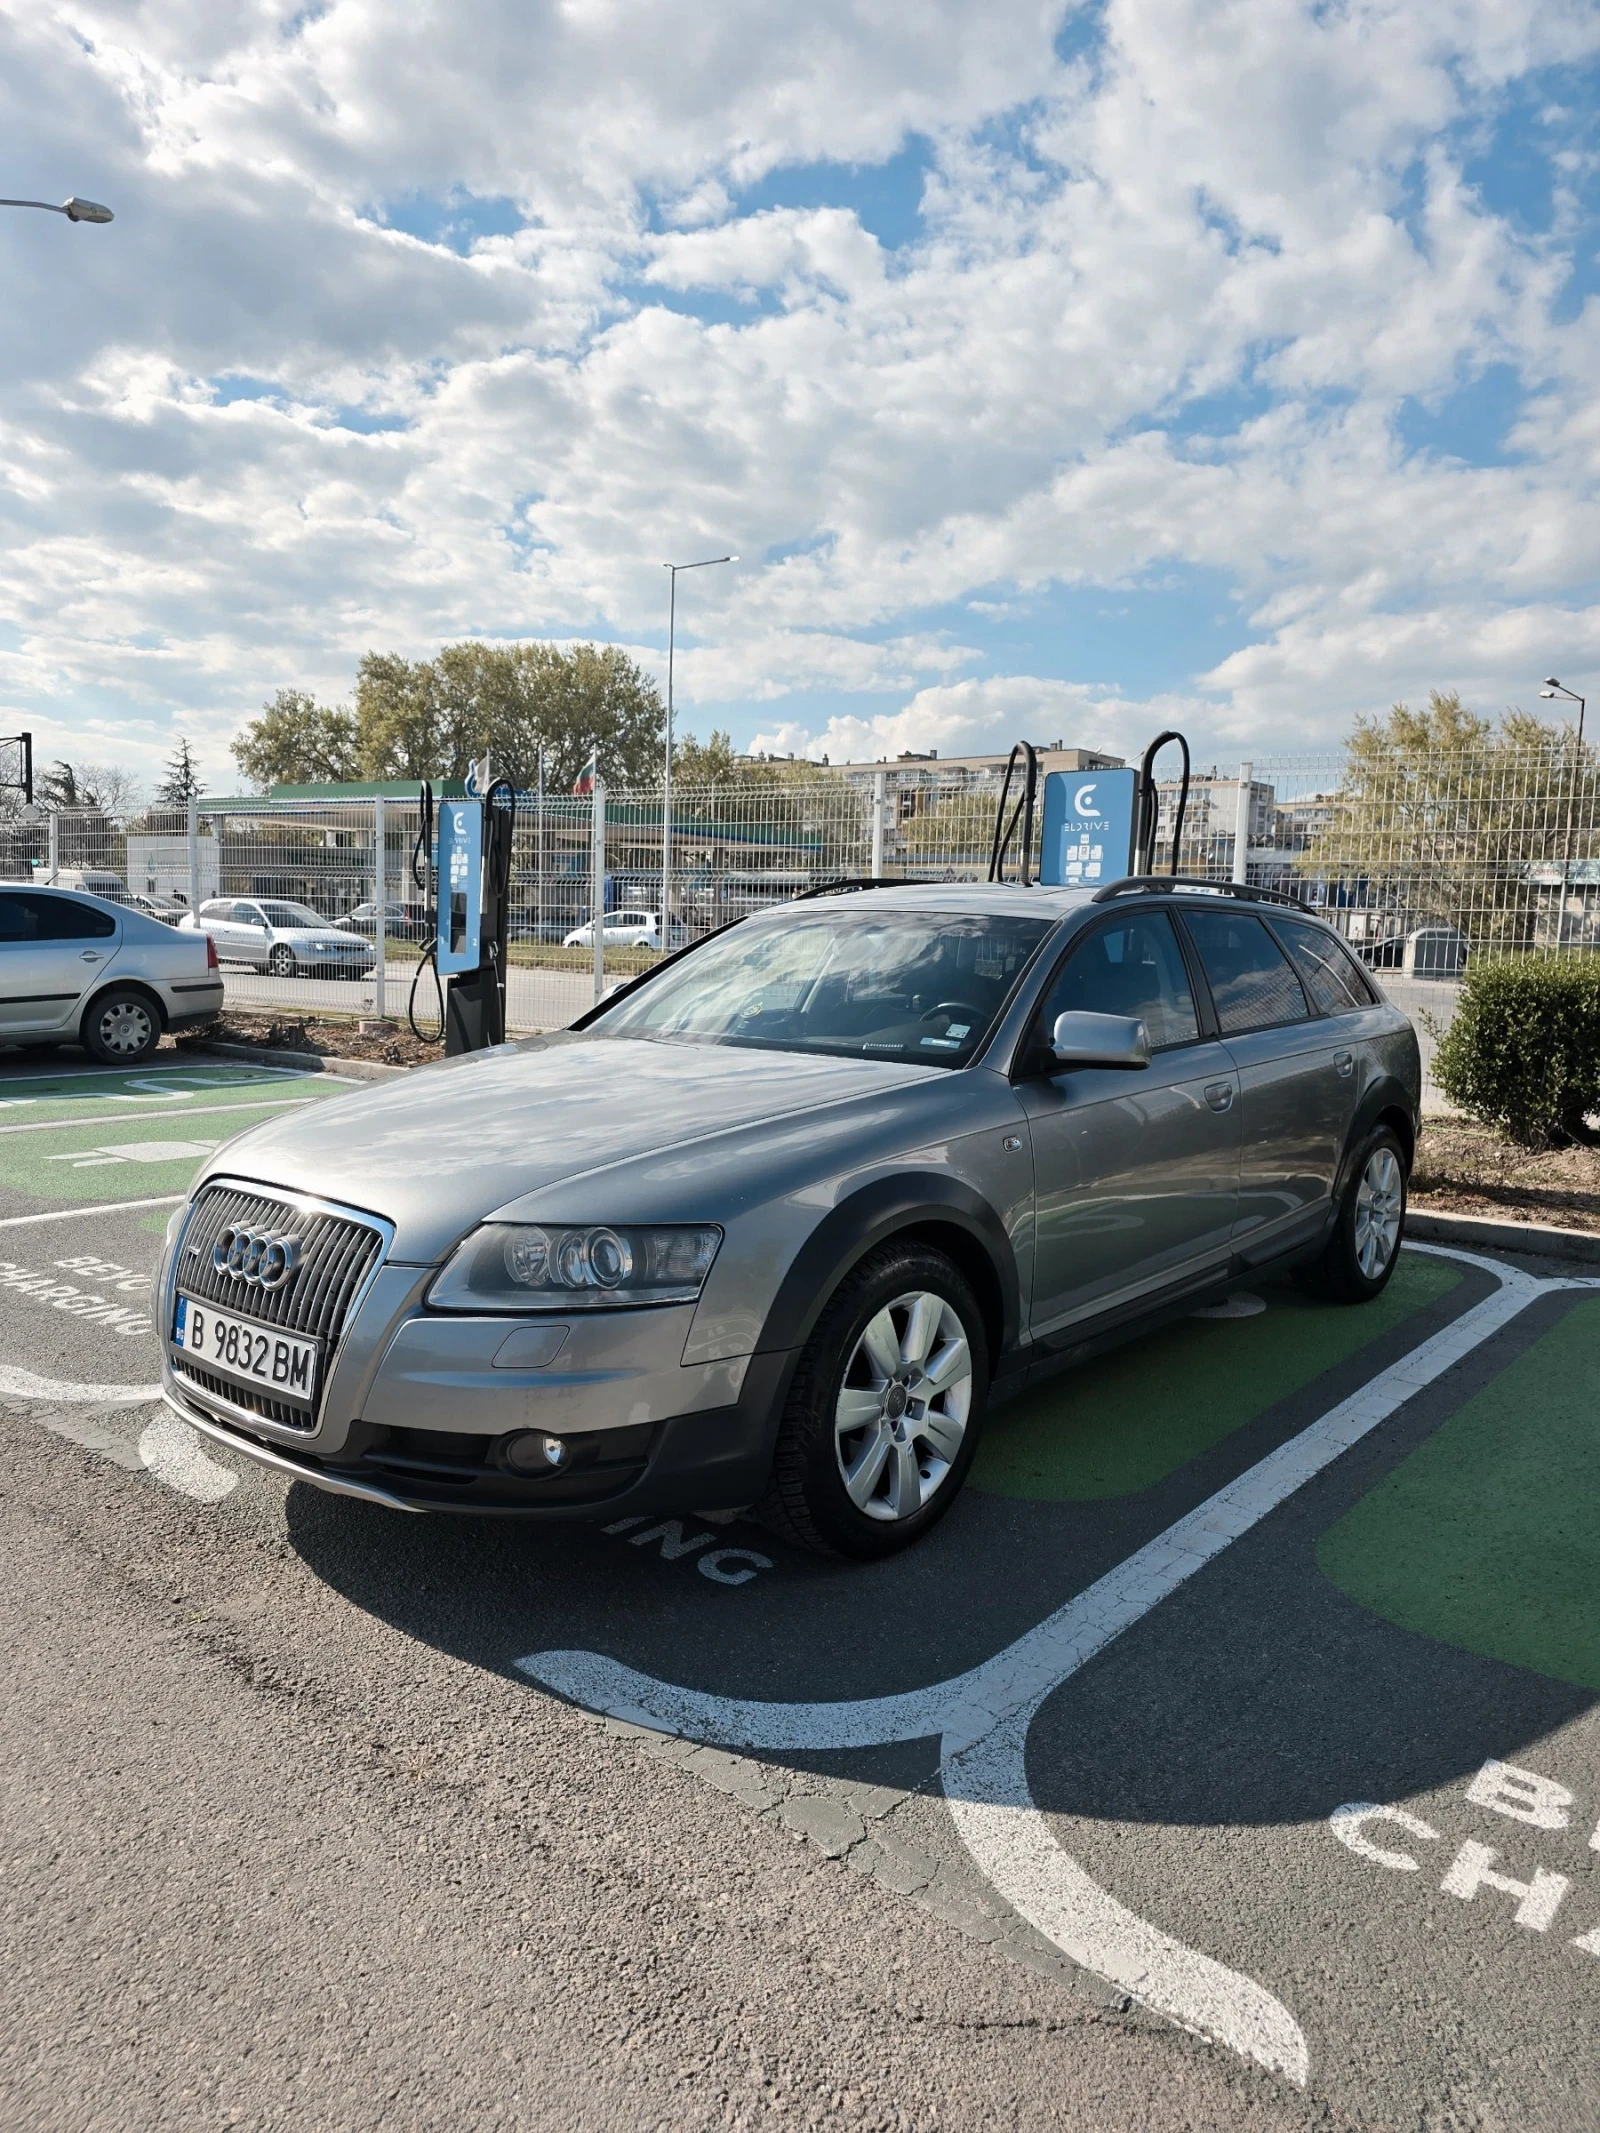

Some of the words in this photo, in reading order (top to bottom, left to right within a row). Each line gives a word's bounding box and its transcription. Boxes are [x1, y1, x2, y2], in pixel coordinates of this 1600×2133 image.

[1064, 821, 1109, 832] ELDRIVE
[472, 937, 478, 947] 2
[53, 1256, 152, 1291] BEYO
[191, 1309, 205, 1350] B
[214, 1320, 269, 1377] 9832
[272, 1339, 311, 1391] BM
